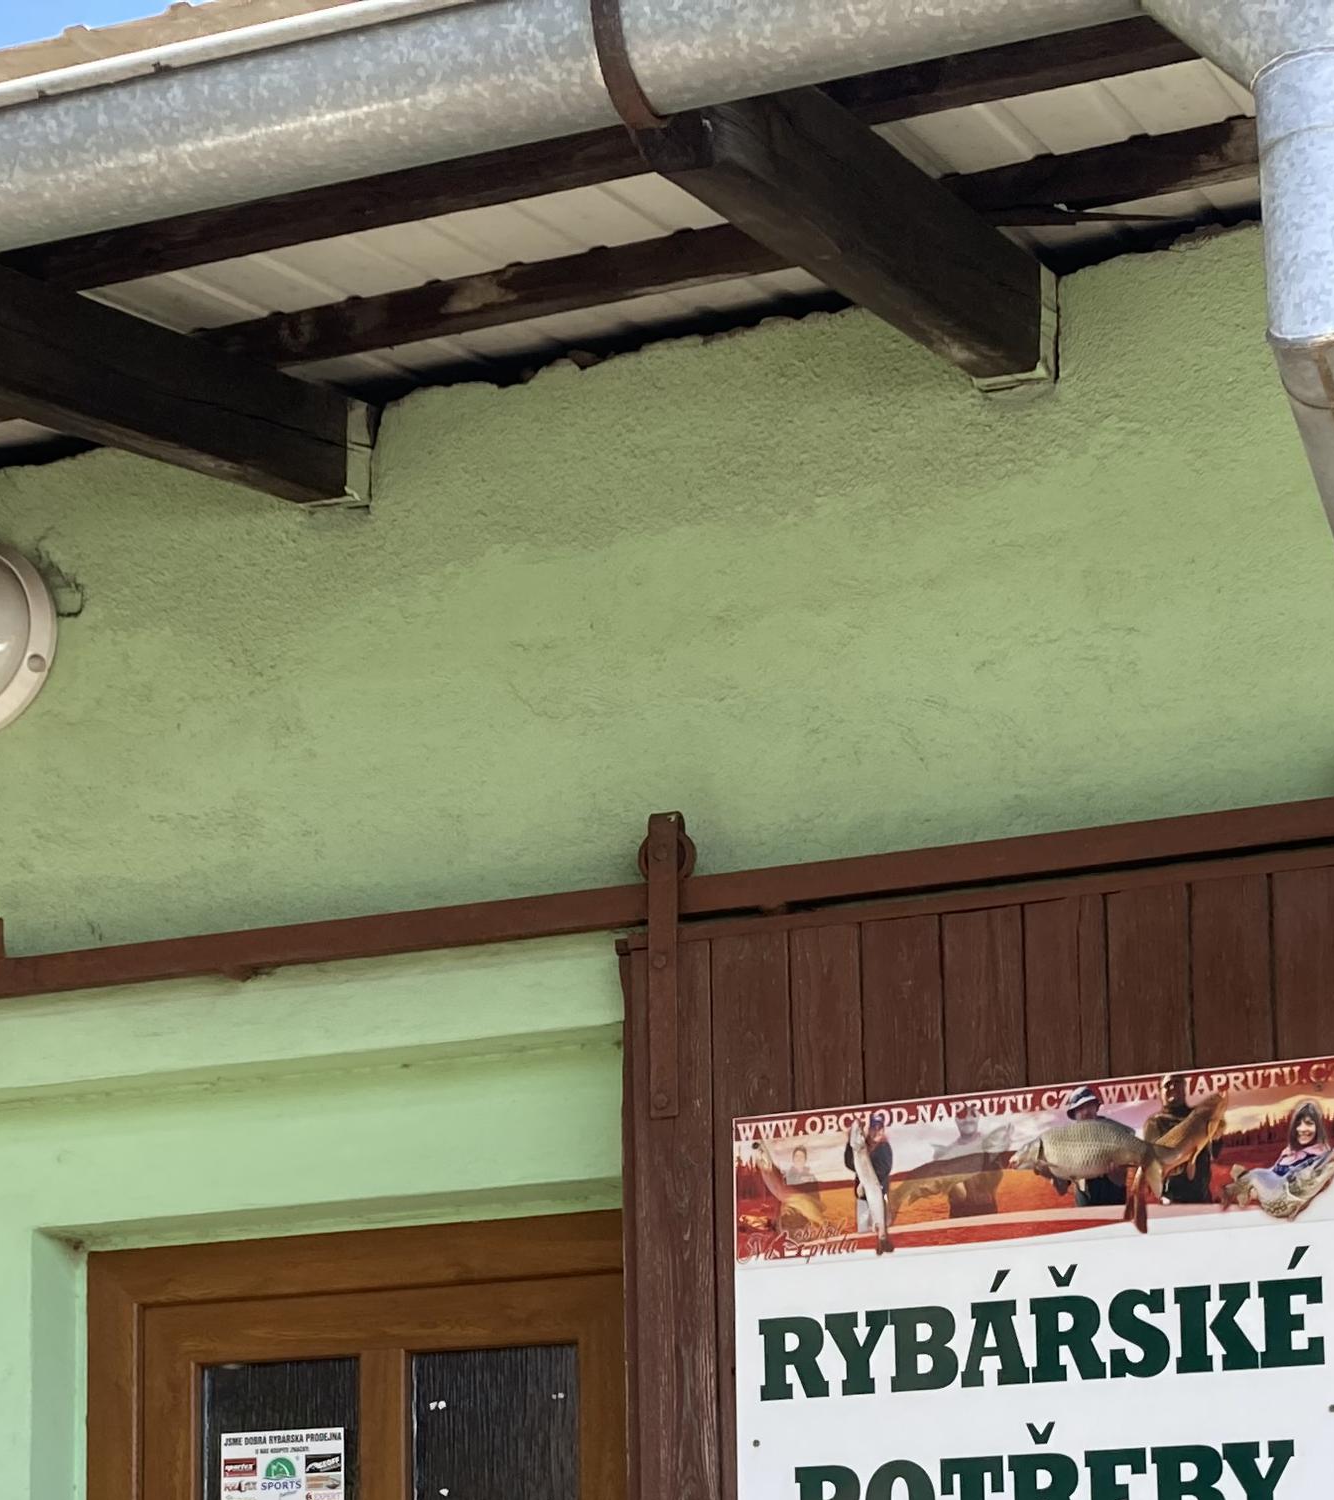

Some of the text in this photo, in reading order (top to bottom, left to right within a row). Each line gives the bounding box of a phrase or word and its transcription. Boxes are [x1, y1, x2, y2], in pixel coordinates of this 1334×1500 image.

[758, 1245, 1326, 1402] RYBÁŘSKÉ
[224, 1437, 243, 1447] JSME
[261, 1480, 302, 1491] SPORTS
